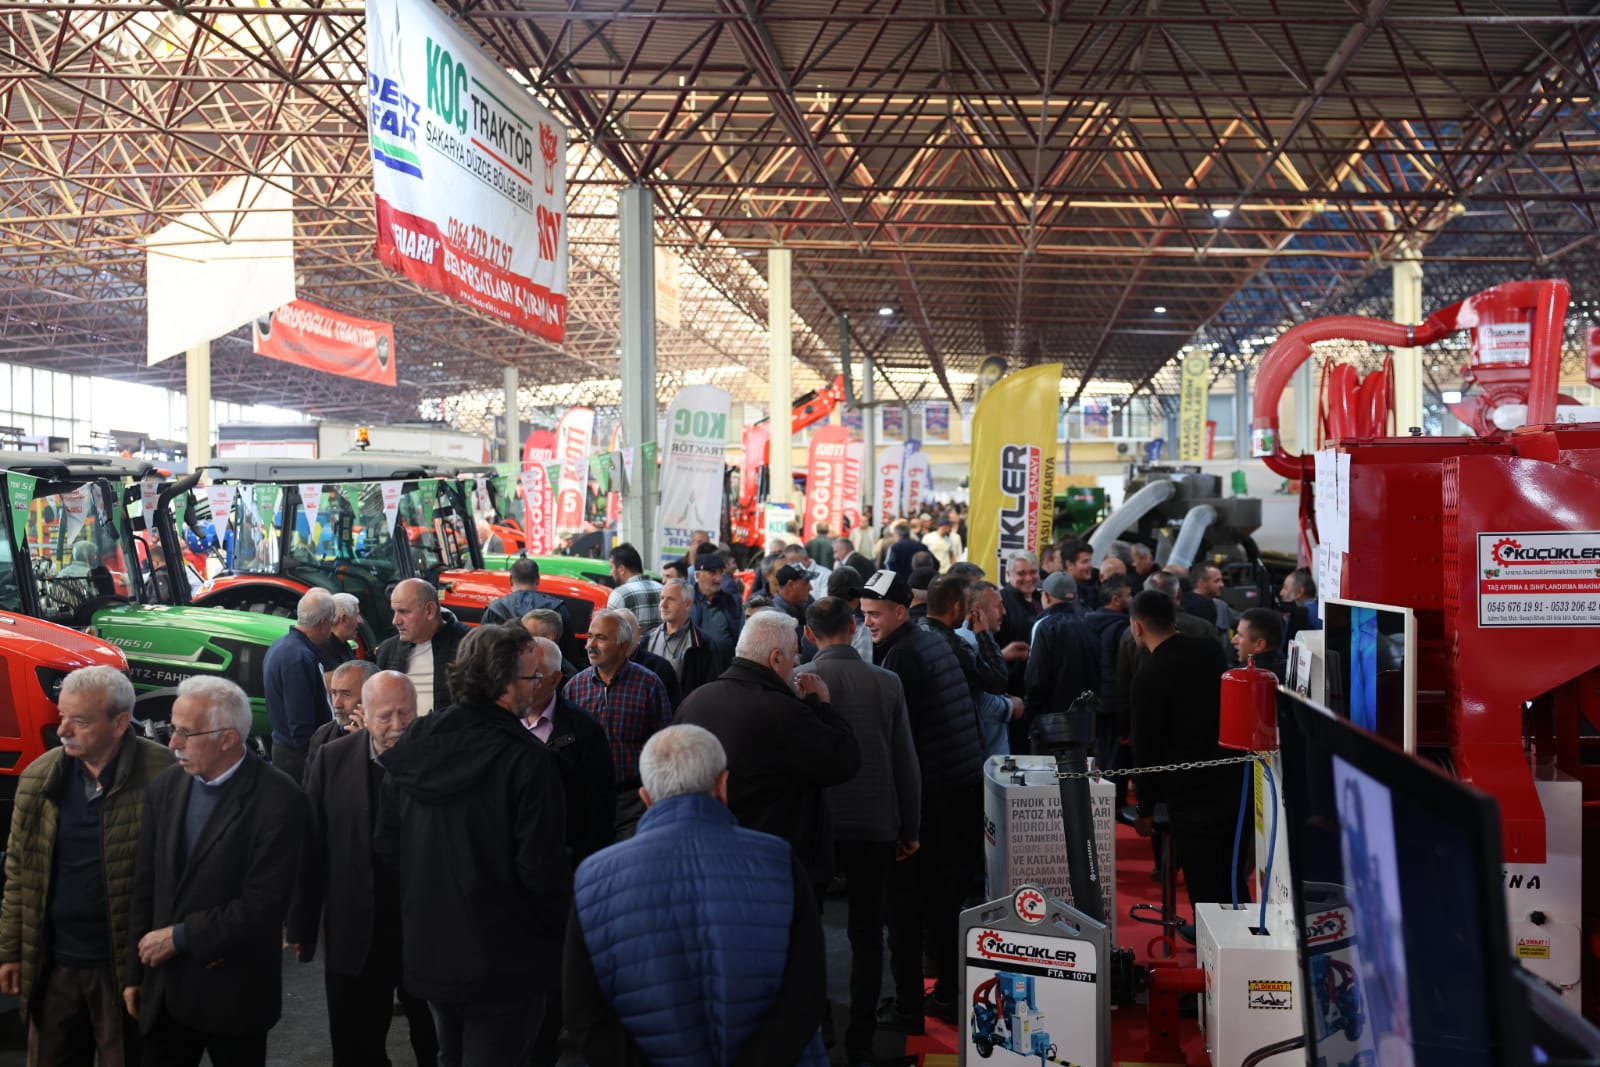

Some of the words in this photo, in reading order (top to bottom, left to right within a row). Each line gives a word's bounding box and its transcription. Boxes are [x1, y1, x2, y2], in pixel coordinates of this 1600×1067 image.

[471, 94, 533, 173] TRAKTÖR
[426, 120, 465, 164] SAKARYA
[466, 147, 492, 183] DÜZCE
[493, 167, 517, 199] BÖLGE
[1043, 457, 1055, 510] SAKARYA
[1530, 583, 1576, 591] SINIFLANDIRMA
[1487, 602, 1506, 612] 0545
[1507, 601, 1521, 612] 676
[1523, 601, 1532, 611] 19
[1534, 601, 1543, 611] 91
[1551, 601, 1570, 611] 0533
[1571, 600, 1585, 611] 206
[1587, 600, 1597, 611] 42
[1011, 798, 1045, 807] FINDIK
[1099, 796, 1111, 805] VE
[1012, 809, 1044, 819] PATOZ
[1012, 834, 1023, 843] SU
[1013, 855, 1025, 865] VE
[1027, 854, 1068, 865] KATLAM
[995, 941, 1076, 962] KÜÇÜKLER
[1048, 968, 1064, 978] FTA
[1072, 971, 1092, 981] 1071
